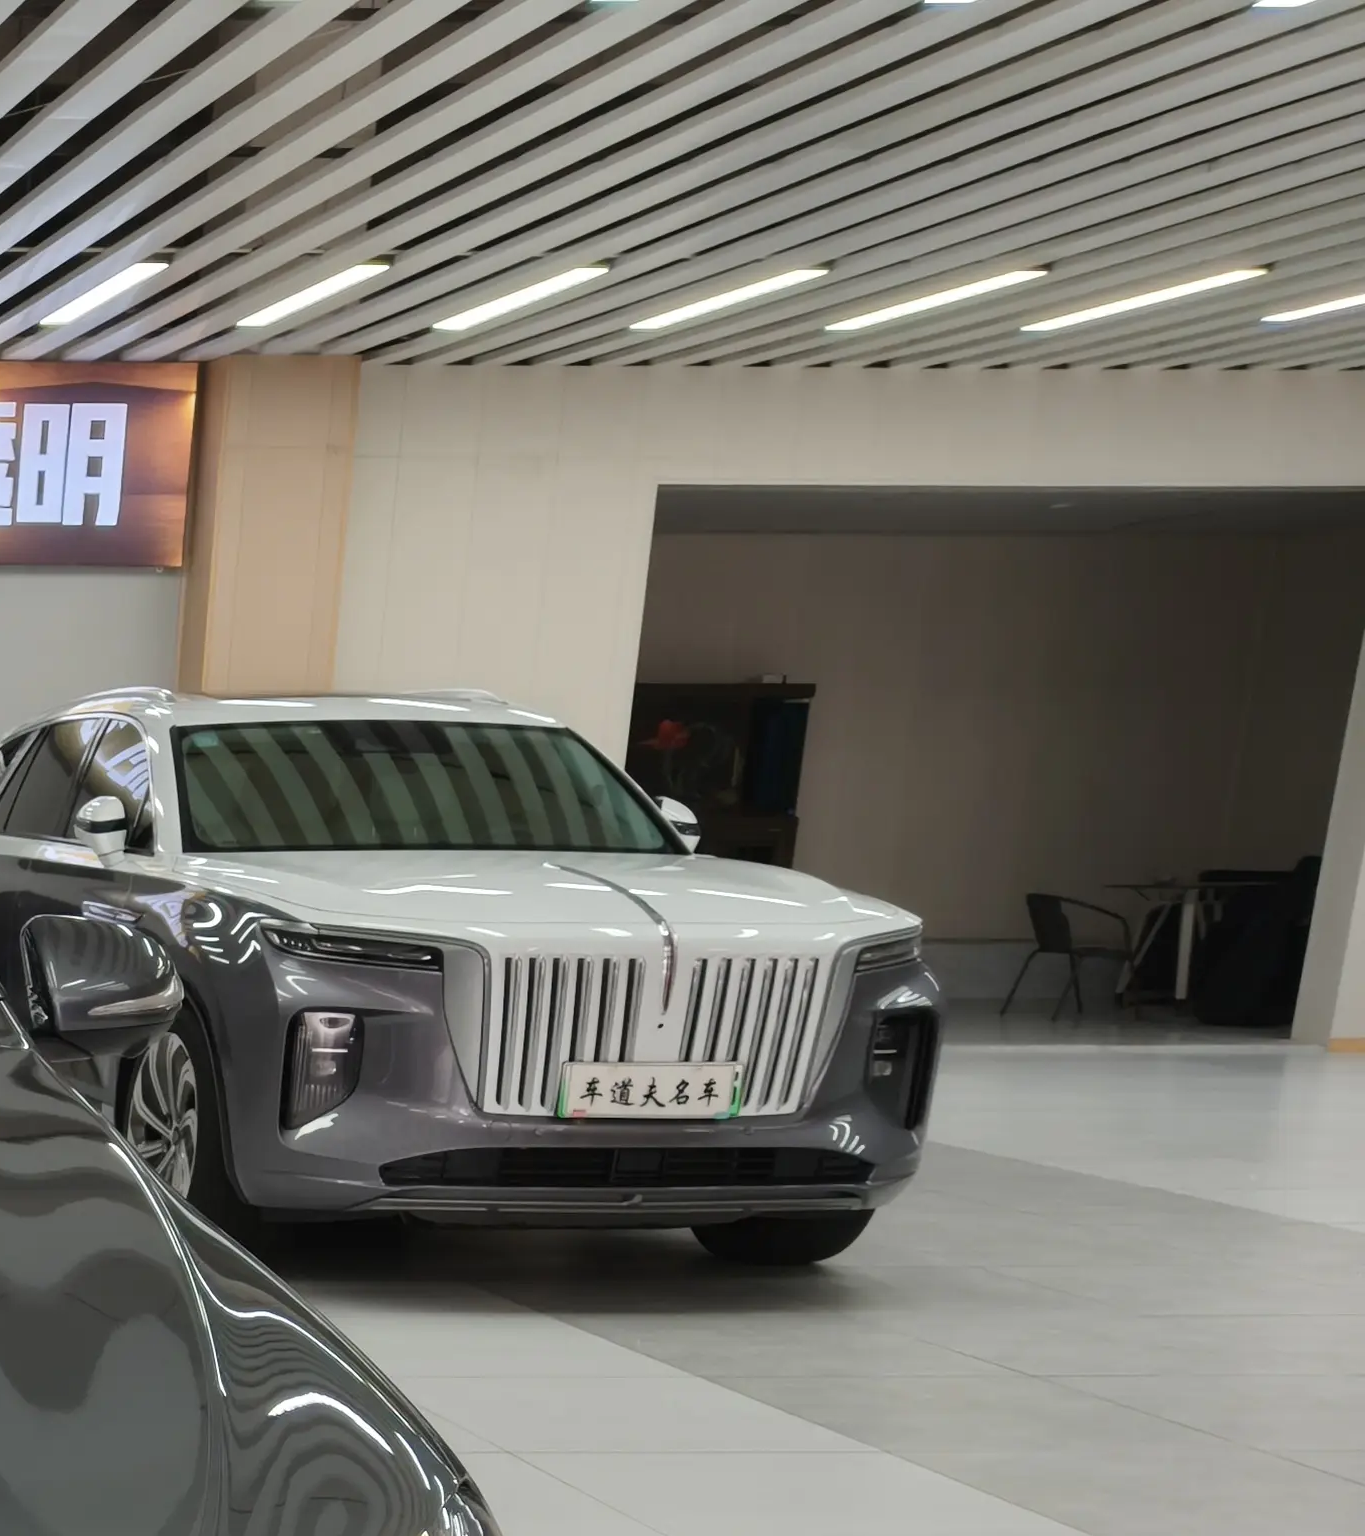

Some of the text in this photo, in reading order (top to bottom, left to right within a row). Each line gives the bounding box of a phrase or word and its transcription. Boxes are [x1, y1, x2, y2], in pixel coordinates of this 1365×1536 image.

[579, 1076, 720, 1107] 车道夫名车
